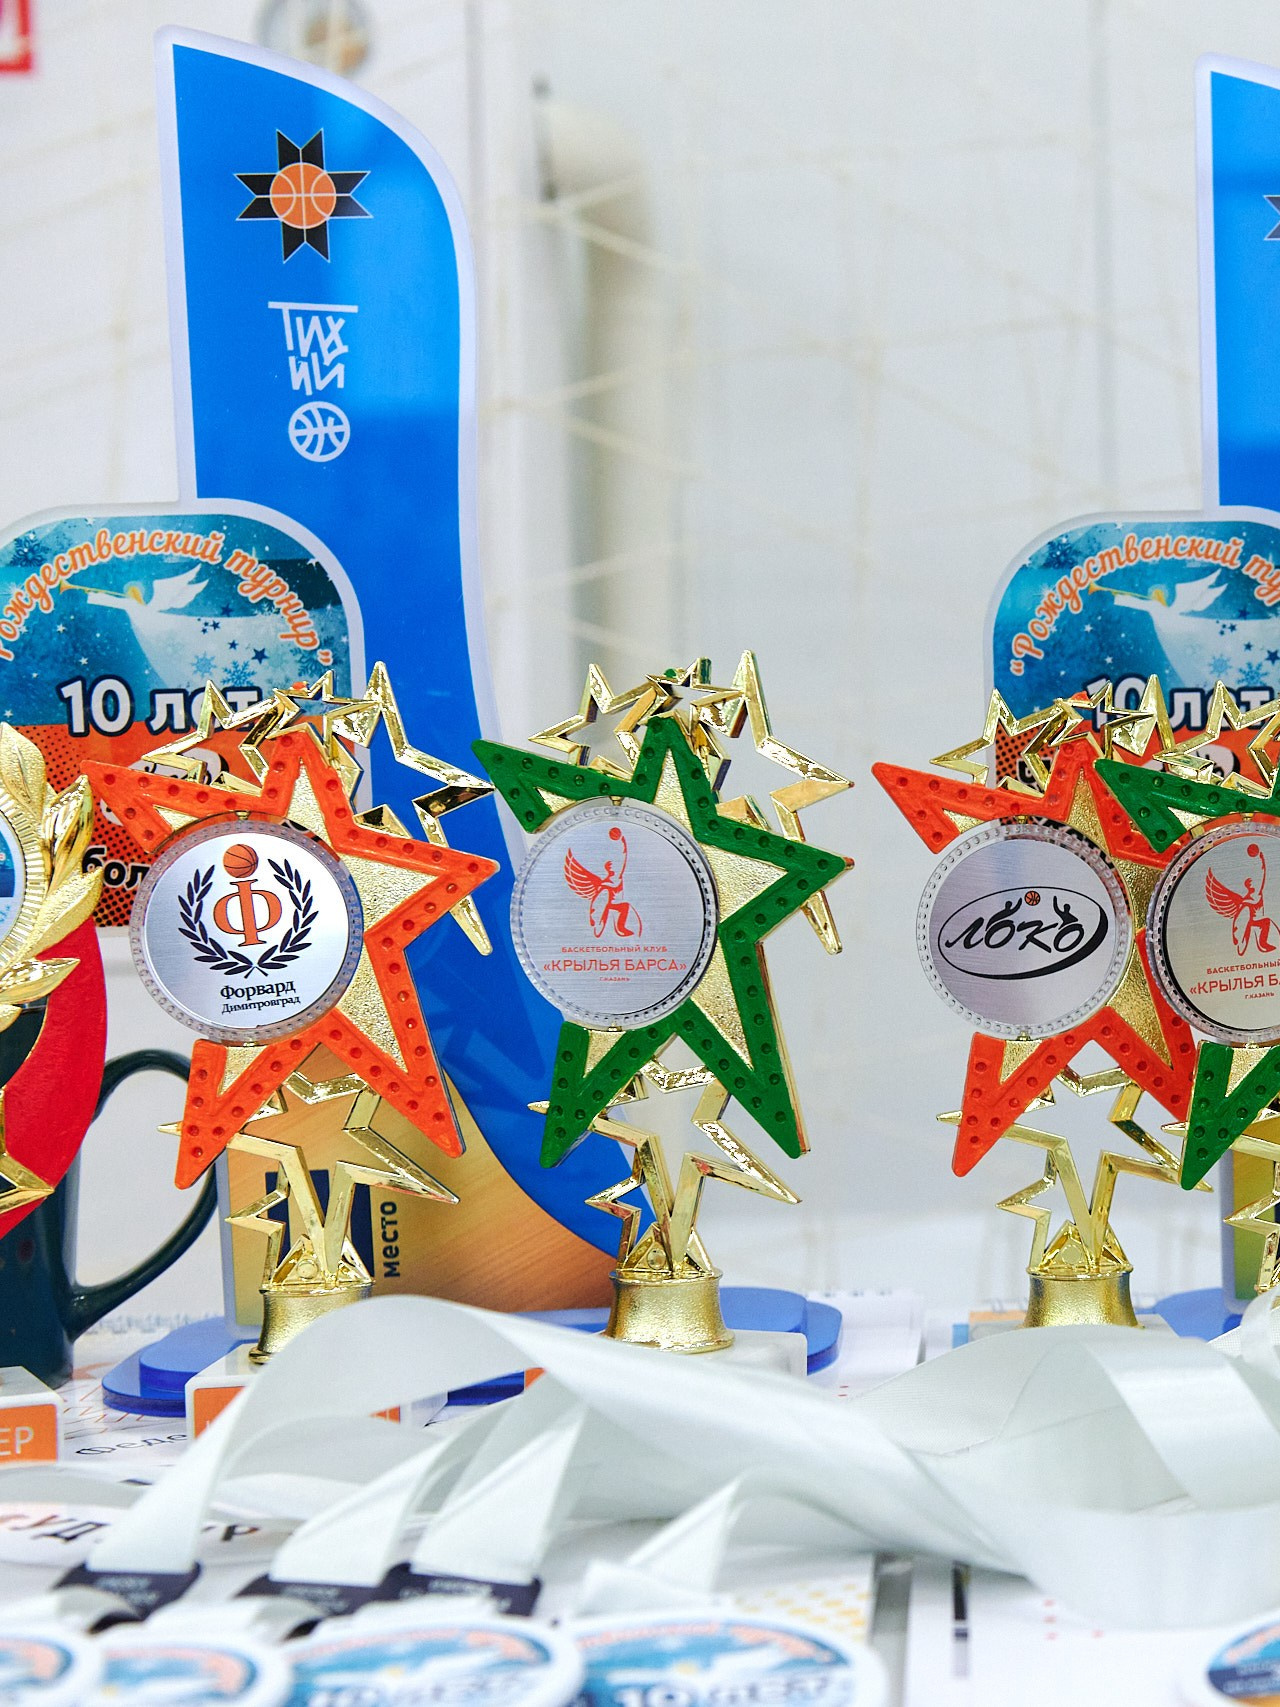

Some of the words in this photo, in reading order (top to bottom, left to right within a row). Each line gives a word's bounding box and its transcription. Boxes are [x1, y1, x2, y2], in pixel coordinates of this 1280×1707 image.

[0, 528, 225, 661] ождественский
[58, 676, 134, 737] 10
[561, 945, 641, 953] БАСКЕТБОЛЬНЫЙ
[543, 959, 620, 971] «КРЫЛЬЯ
[624, 958, 687, 971] БАРСА»
[220, 980, 296, 1001] Форвард
[1190, 976, 1265, 995] «КРЫЛЬЯ
[222, 995, 301, 1014] Димитровград
[380, 1201, 400, 1278] место
